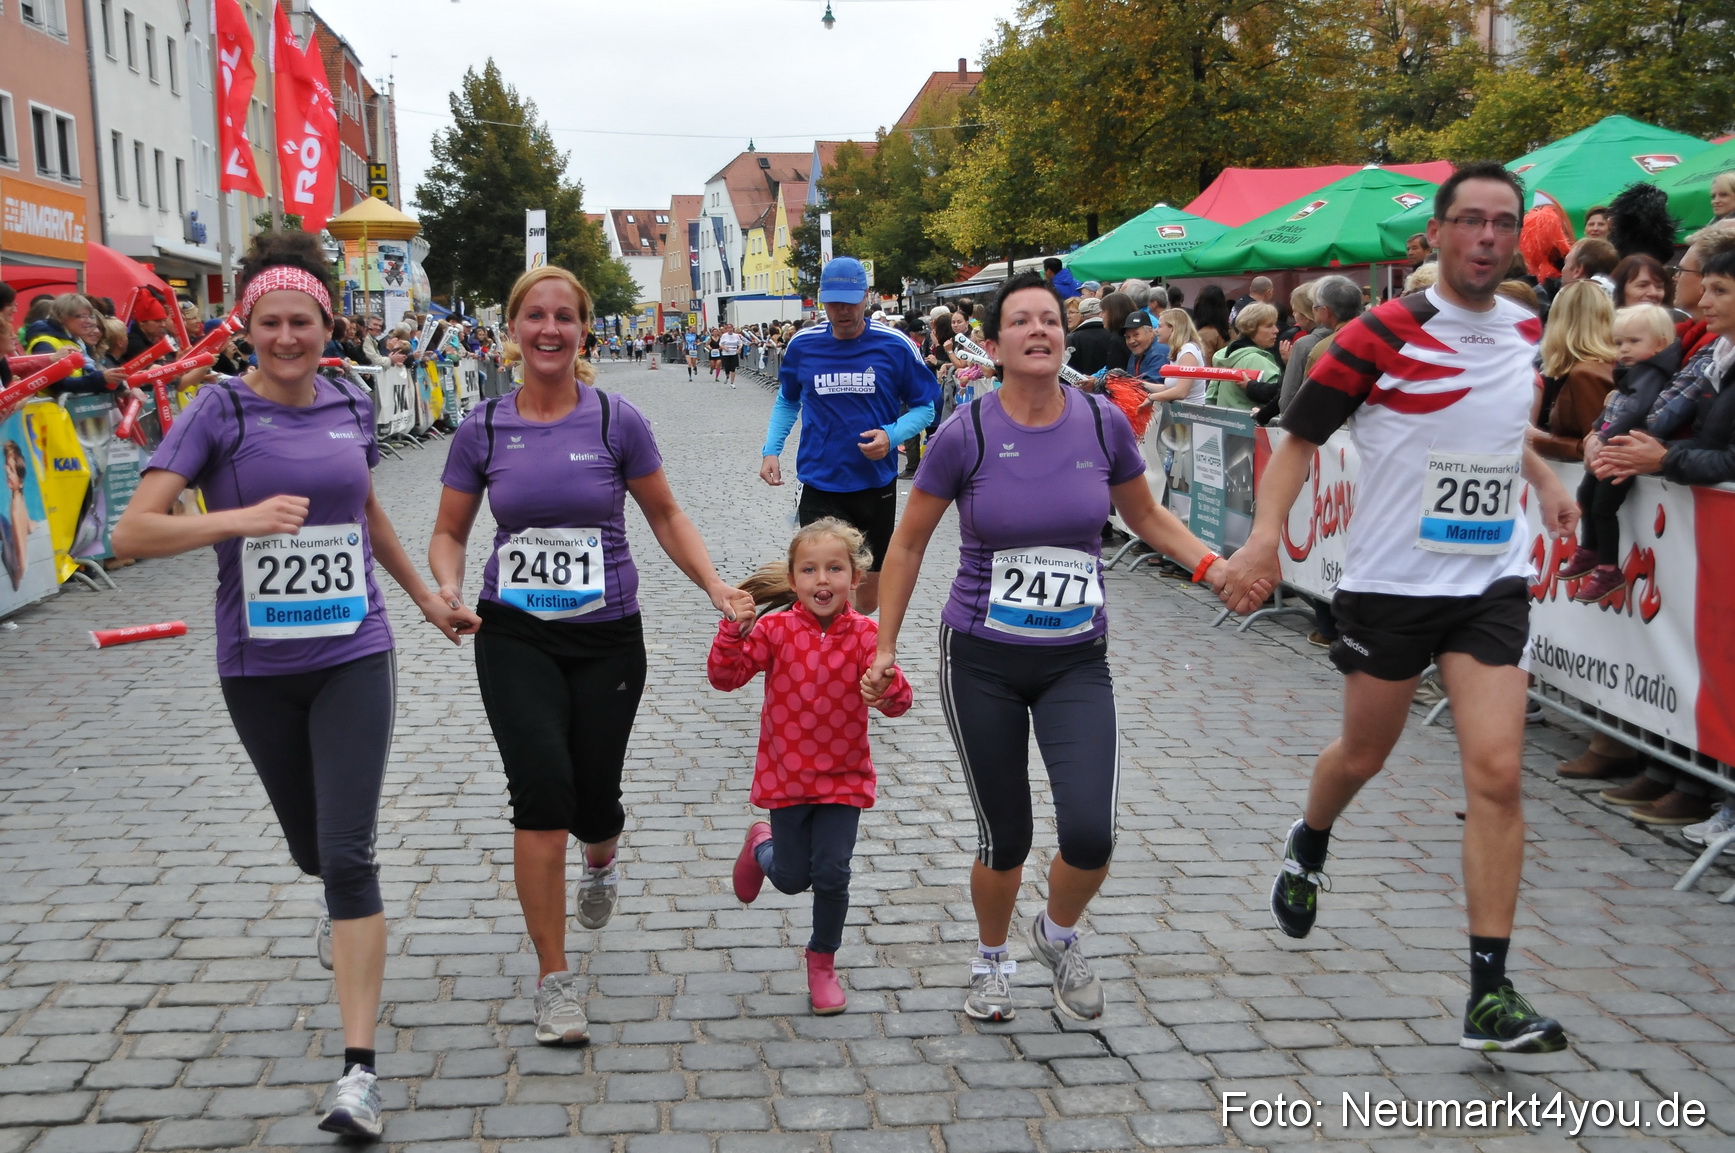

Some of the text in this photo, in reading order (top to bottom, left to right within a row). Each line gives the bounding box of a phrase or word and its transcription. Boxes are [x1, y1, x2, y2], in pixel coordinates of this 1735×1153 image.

[1460, 334, 1496, 345] adidas
[967, 341, 984, 356] BMW
[147, 370, 163, 379] Audi
[814, 372, 876, 388] HUBER
[828, 386, 874, 394] TECHNOLOGY
[570, 452, 599, 462] Kristina
[1429, 460, 1514, 475] PARTL Neumarkt
[1433, 477, 1513, 516] 2631
[1446, 524, 1501, 541] Manfred
[246, 536, 344, 551] PARTL Neumarkt
[535, 537, 584, 548] Neumarkt
[509, 550, 590, 585] 2481
[995, 554, 1084, 570] PARTL Neumarkt
[257, 552, 355, 595] 2233
[1002, 567, 1089, 607] 2477
[250, 593, 256, 601] D
[526, 593, 578, 608] Kristina
[266, 605, 351, 623] Bernadette
[1023, 613, 1062, 628] Anita
[1342, 635, 1369, 657] adidas
[1624, 662, 1678, 714] Radio
